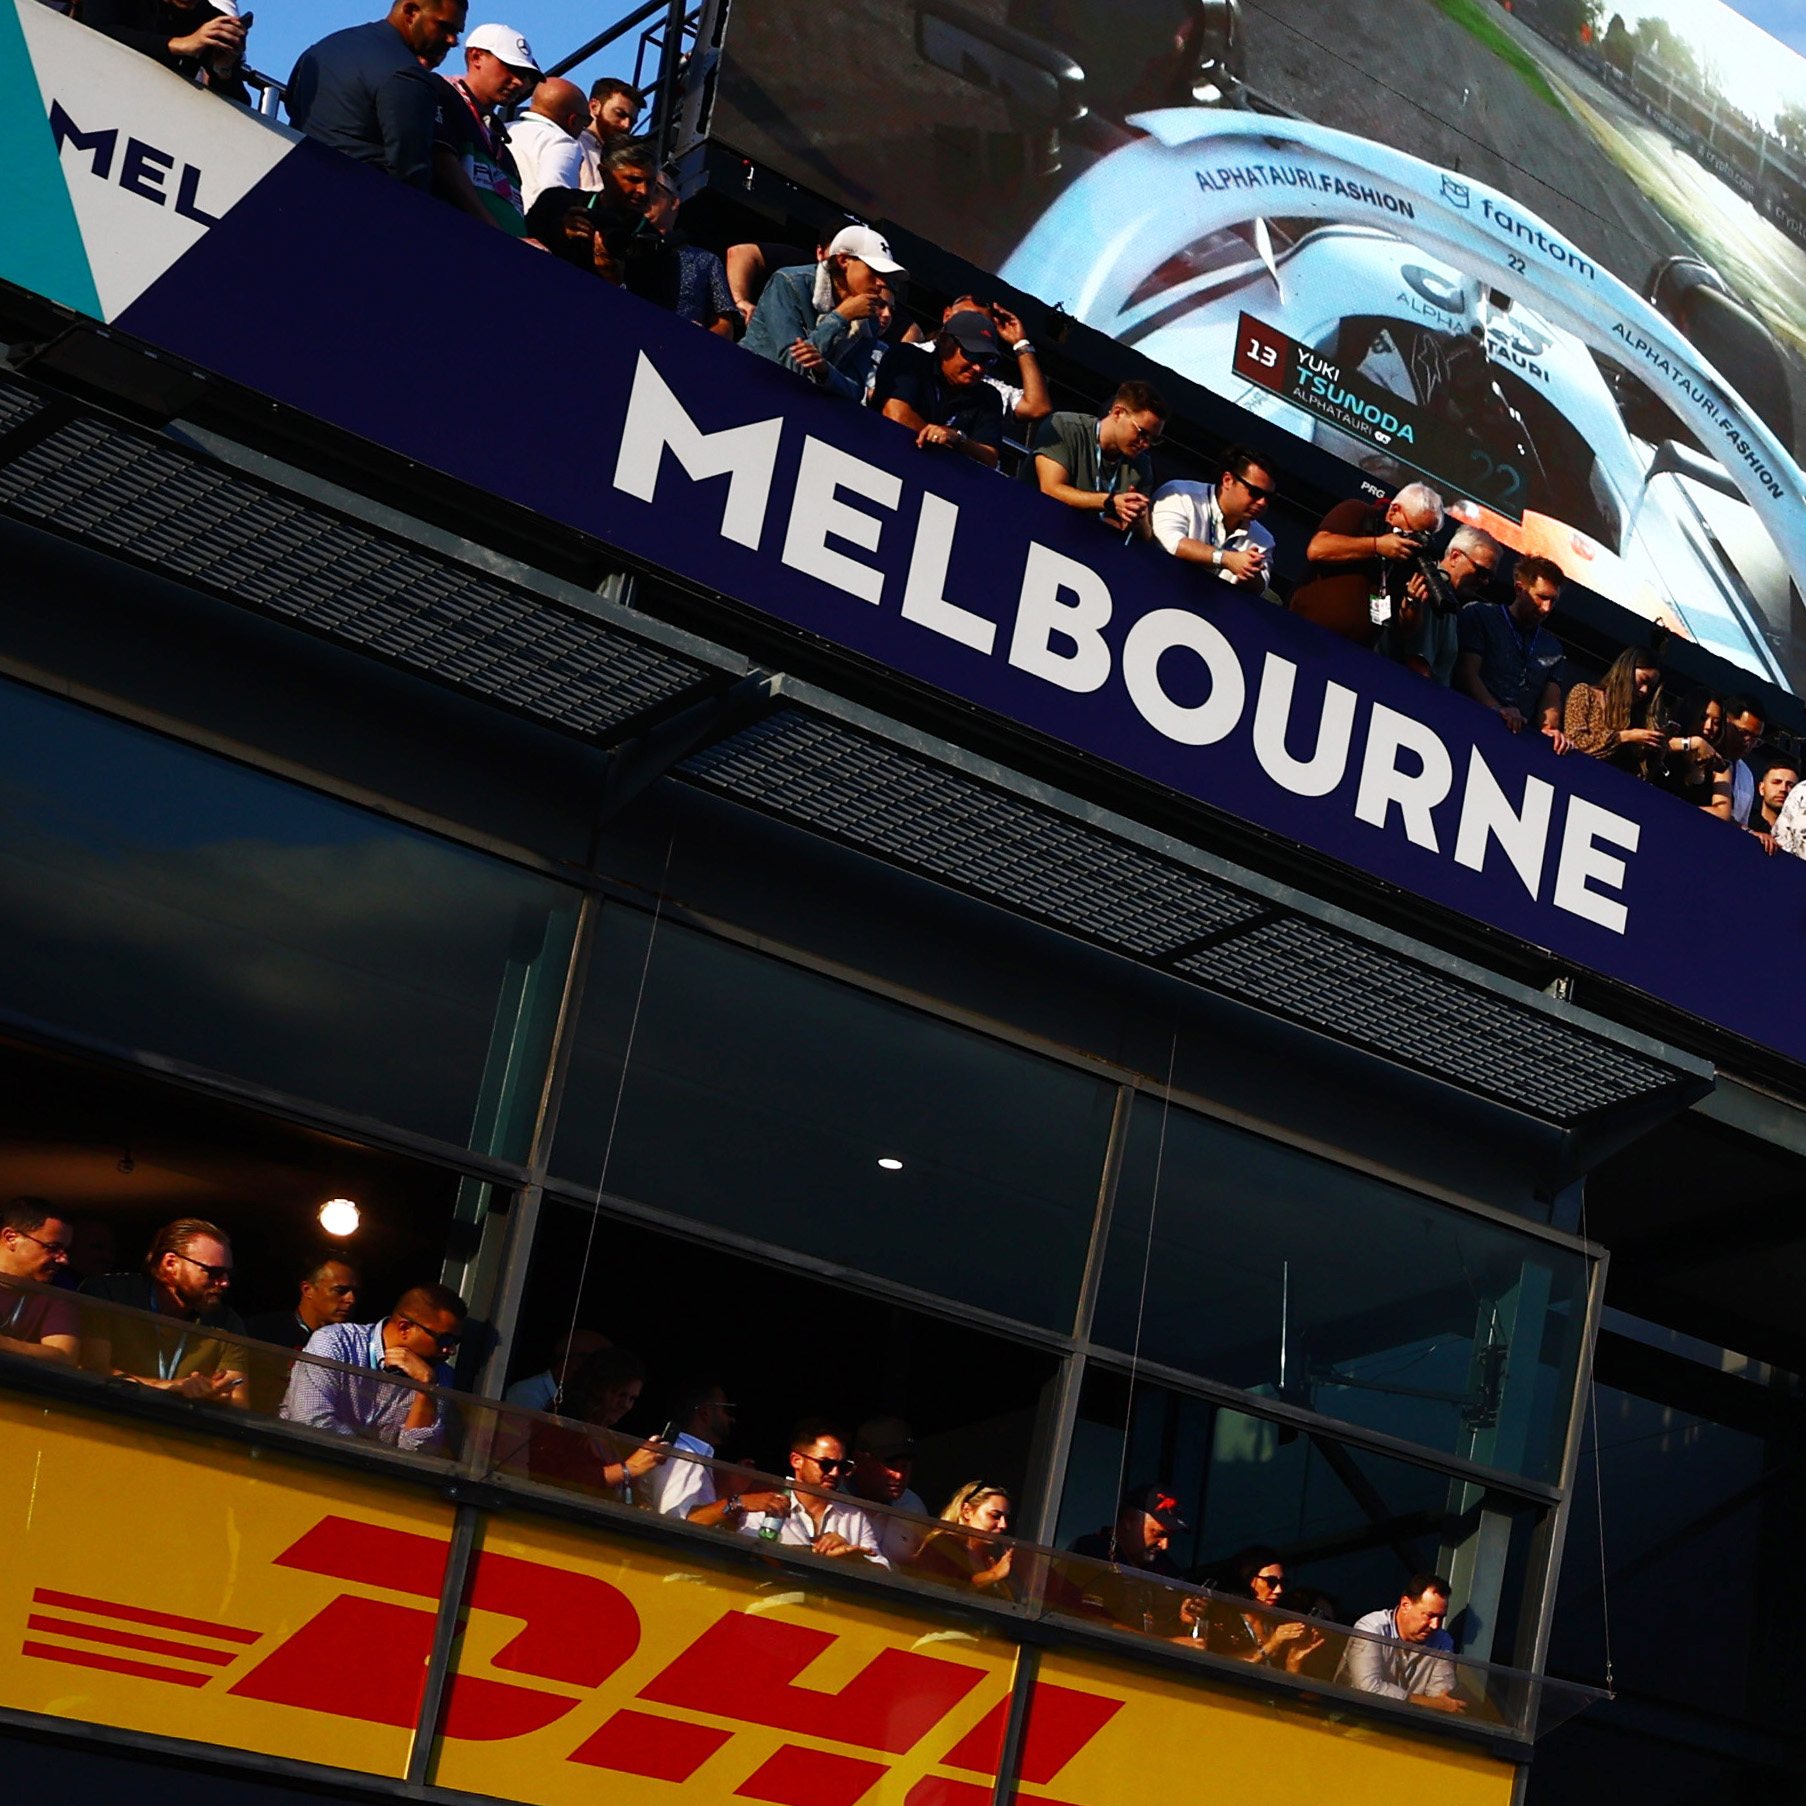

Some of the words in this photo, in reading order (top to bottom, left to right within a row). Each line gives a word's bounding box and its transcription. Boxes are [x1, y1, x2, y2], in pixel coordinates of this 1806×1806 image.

[49, 100, 219, 227] MEL
[1196, 165, 1415, 219] ALPHATAURI.FASHION
[1481, 199, 1596, 280] fantom
[1507, 254, 1527, 276] 22
[1246, 339, 1279, 369] 13
[1297, 348, 1341, 383] YUKI
[1486, 338, 1551, 383] TAURI
[1292, 387, 1373, 436] ALPHATAURI
[1296, 367, 1416, 445] TSUNODA
[1612, 321, 1785, 500] ALPHATAURI.FASHION
[1360, 480, 1387, 499] PRG
[613, 350, 1641, 942] MELBOURNE
